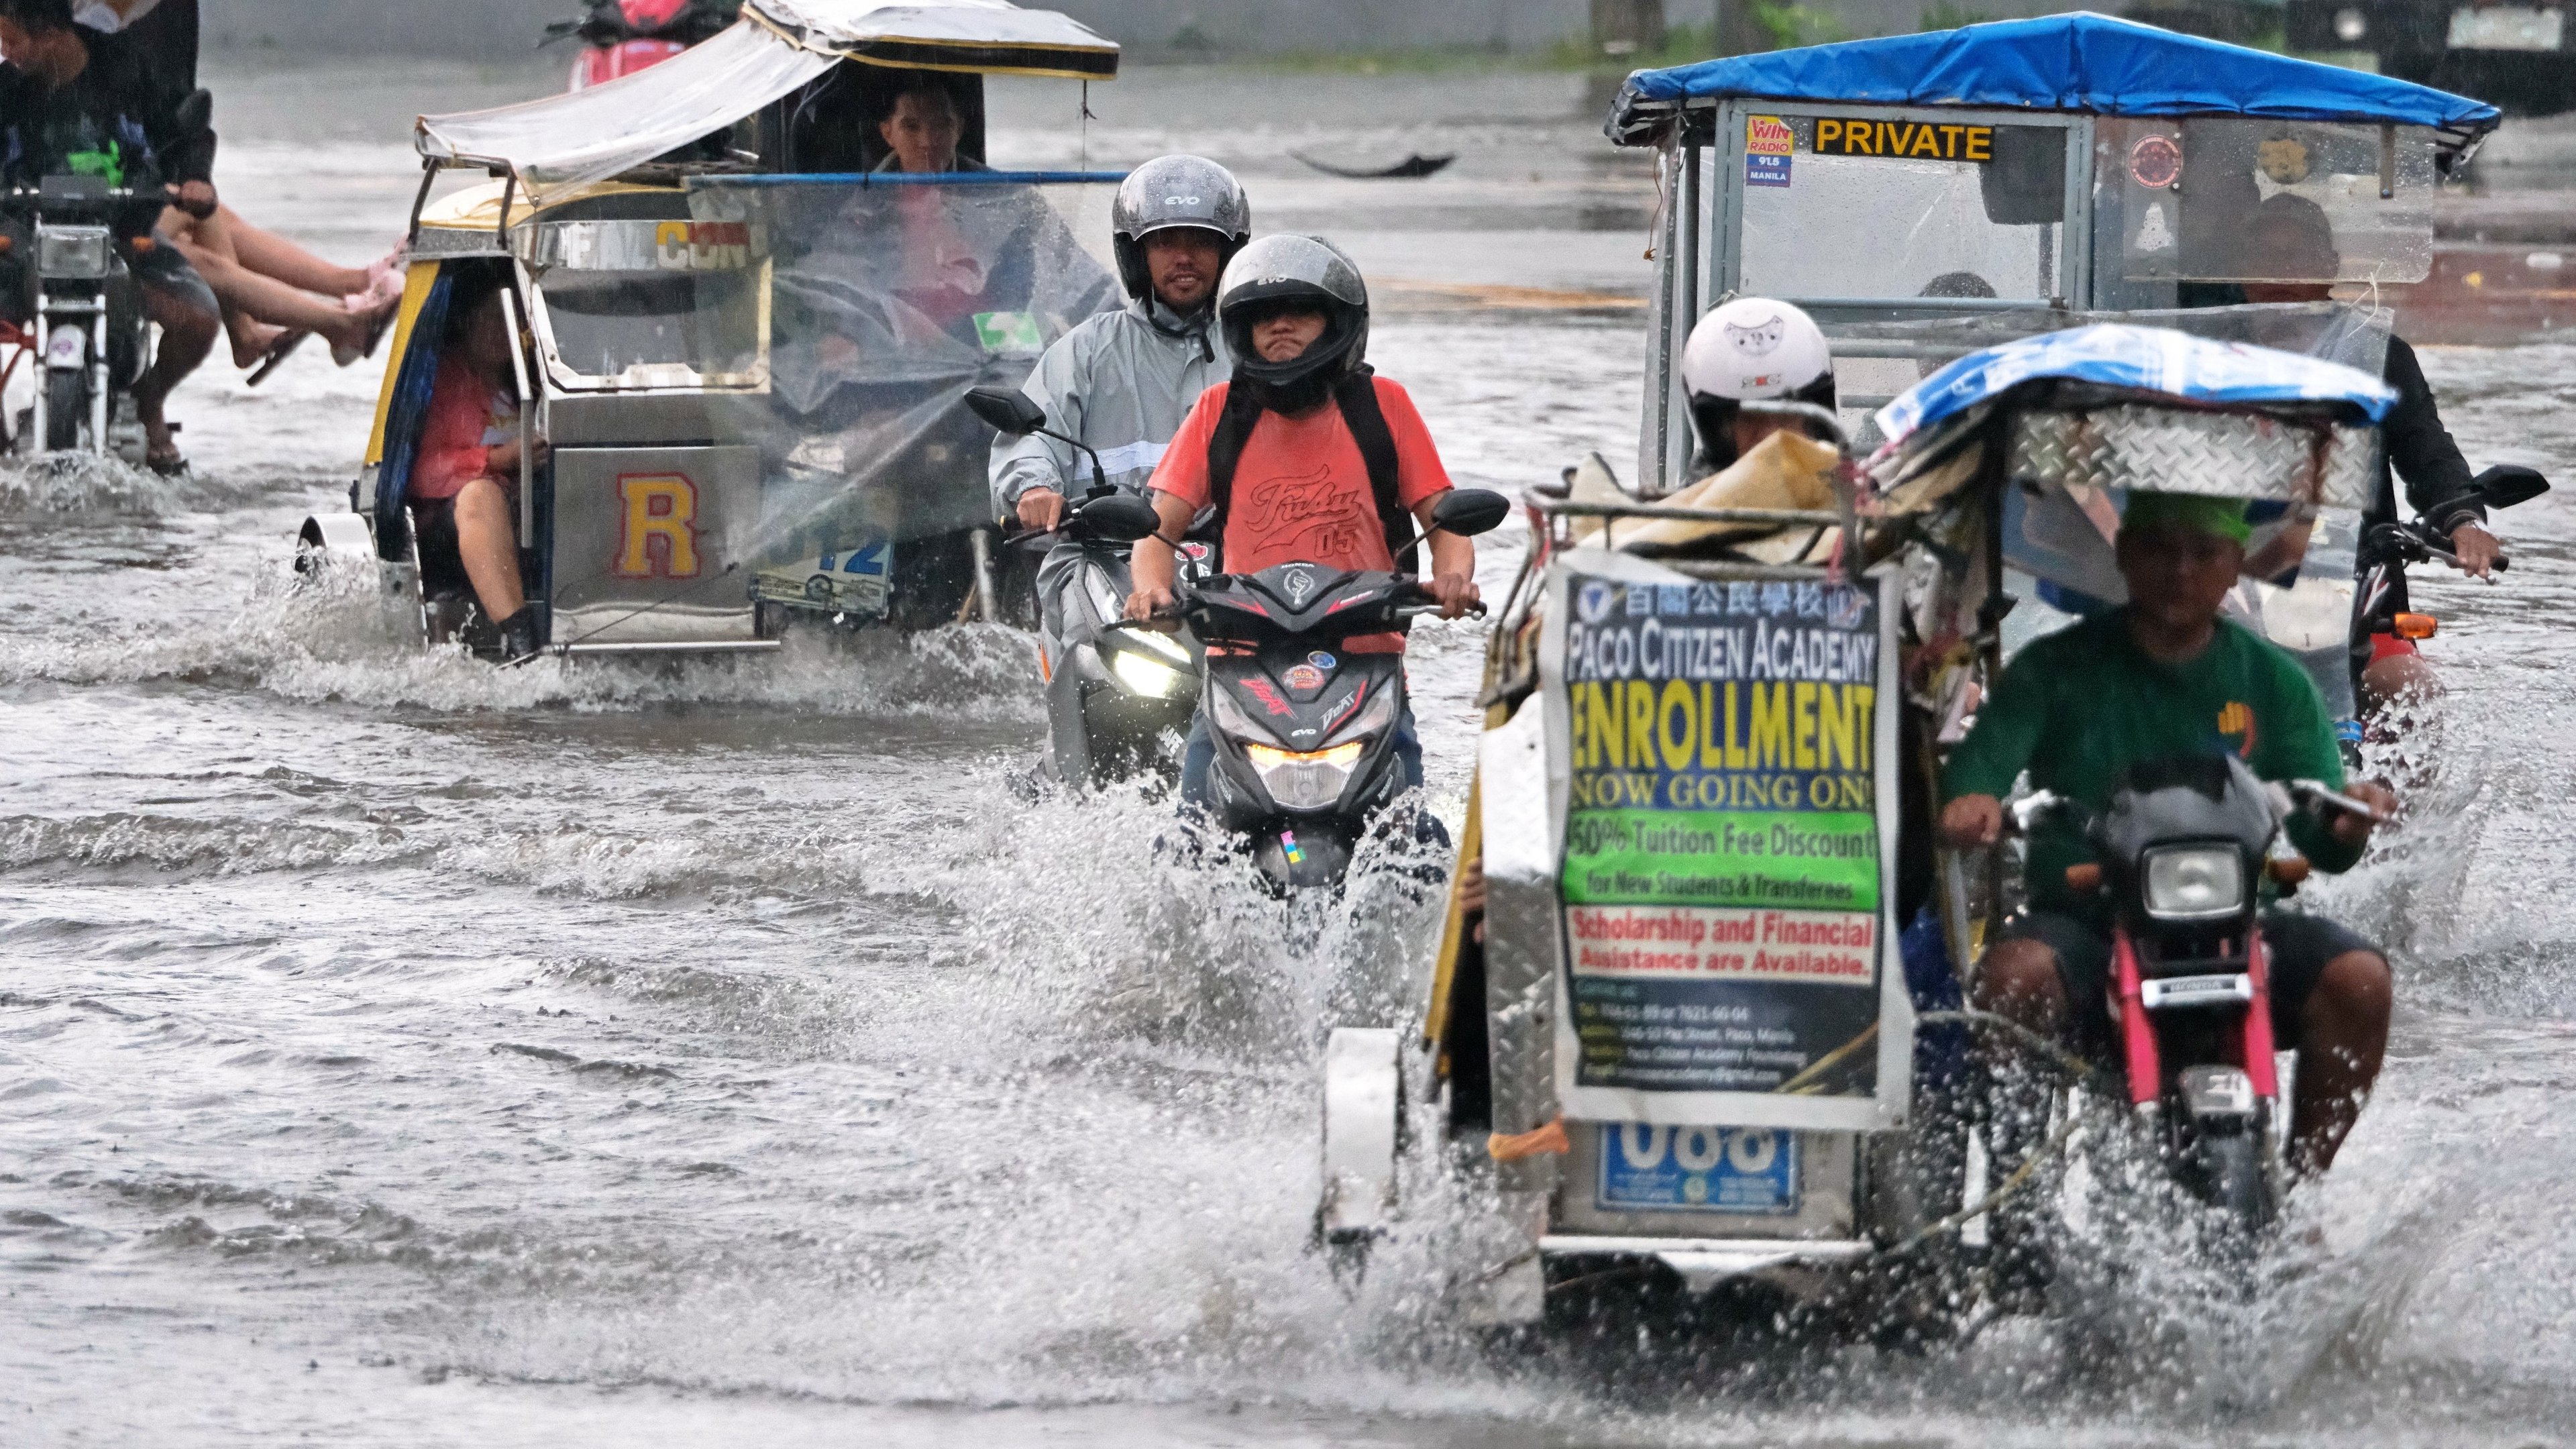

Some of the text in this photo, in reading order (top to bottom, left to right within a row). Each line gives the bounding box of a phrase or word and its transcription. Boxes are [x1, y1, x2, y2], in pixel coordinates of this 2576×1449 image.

[1750, 117, 1790, 140] WIN
[1817, 119, 1992, 160] PRIVATE
[1748, 140, 1790, 153] RADIO
[1750, 170, 1787, 181] MANILA
[1164, 195, 1200, 205] EVO
[1256, 274, 1287, 286] EVO
[613, 472, 702, 580] R
[1313, 523, 1359, 558] 05
[1570, 678, 1875, 772] ENROLLMENT
[1572, 773, 1659, 806] NOW
[1668, 773, 1801, 808] GOING
[1633, 819, 1717, 855] Tuition
[1723, 822, 1764, 857] Fee
[1770, 822, 1876, 860] Discount
[1586, 871, 1611, 894] for
[1614, 873, 1651, 895] New
[1656, 873, 1735, 898] Students
[1736, 875, 1752, 897] &
[1573, 908, 1872, 948] Scholarship and Financial
[1578, 947, 1871, 976] Assistance are Available.
